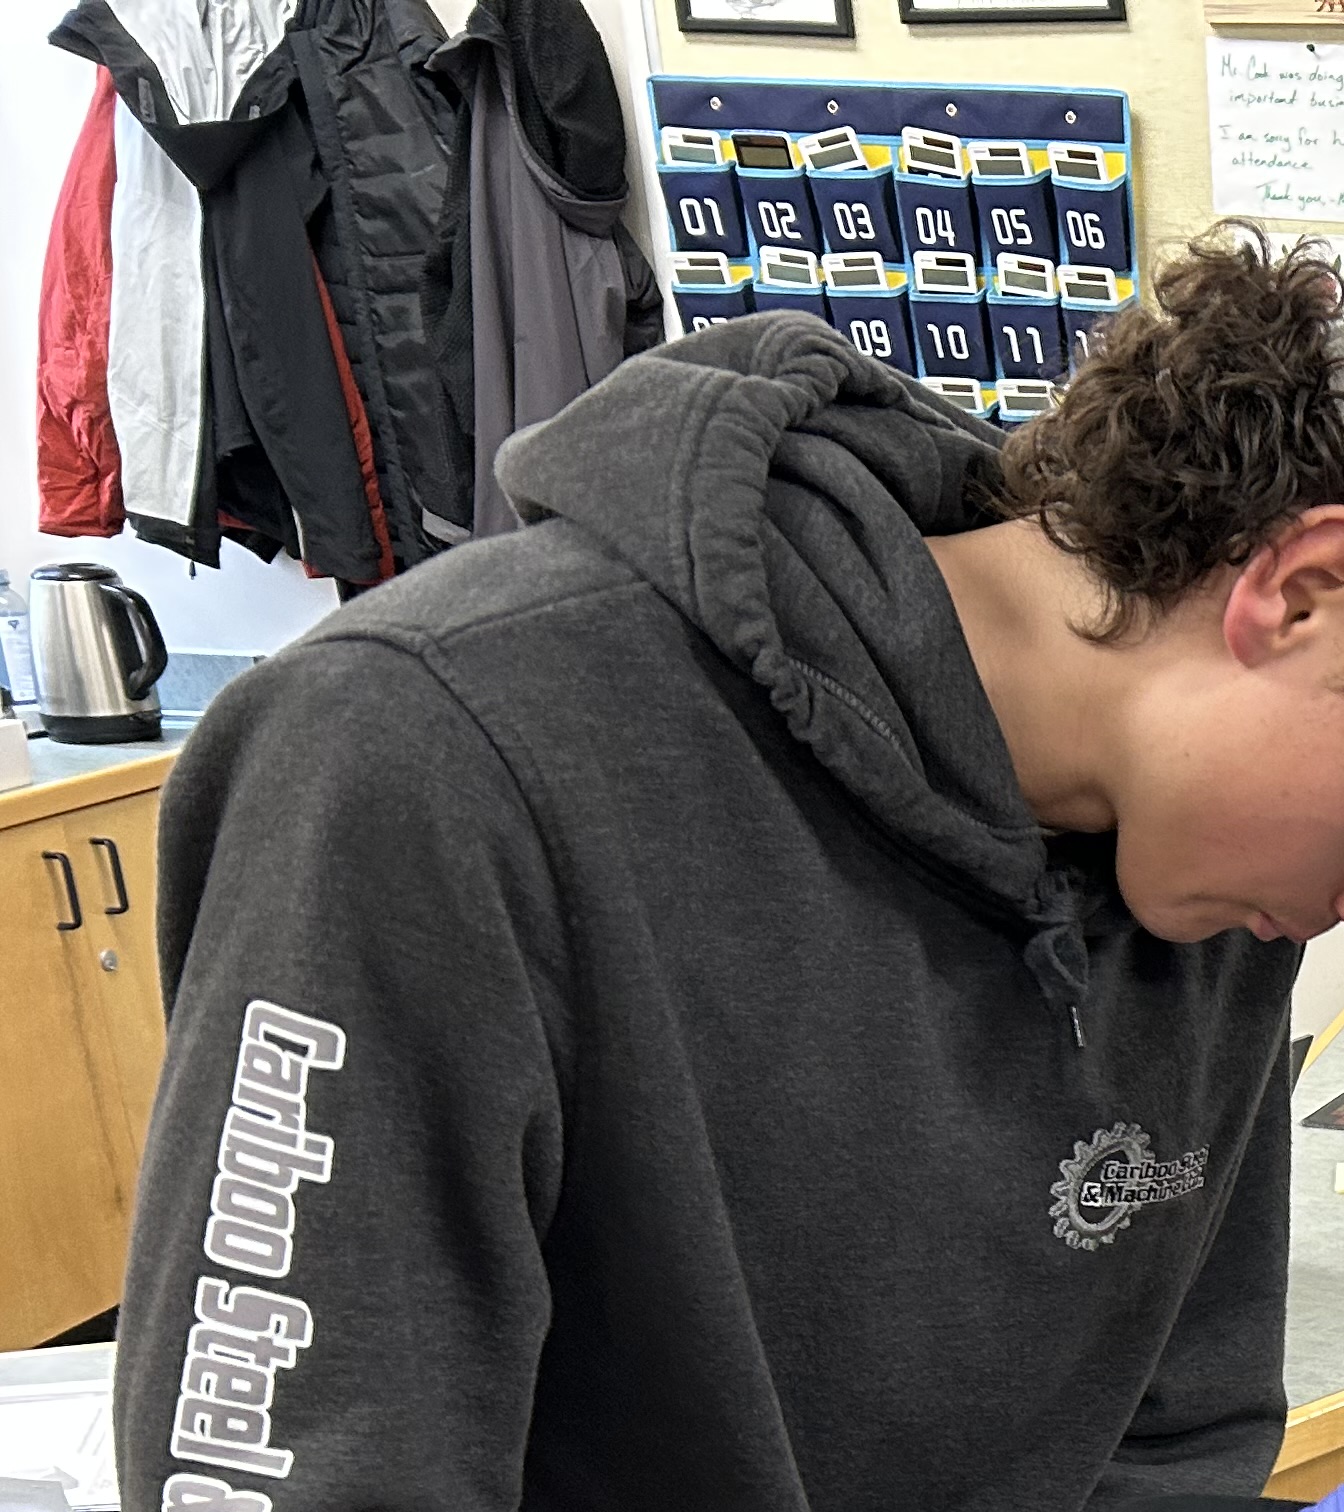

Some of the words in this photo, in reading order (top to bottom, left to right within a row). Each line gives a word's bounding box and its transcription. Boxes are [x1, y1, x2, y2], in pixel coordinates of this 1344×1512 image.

[1279, 71, 1302, 81] was
[1309, 65, 1344, 91] doing
[1229, 90, 1298, 108] important
[1219, 124, 1231, 139] I
[1264, 132, 1291, 152] sorry
[1298, 127, 1319, 147] for
[1232, 152, 1313, 169] attendance
[1256, 179, 1293, 203] Thank
[680, 198, 724, 237] 01
[759, 201, 801, 240] 02
[833, 202, 875, 241] 03
[916, 207, 955, 246] 04
[991, 207, 1032, 246] 05
[1066, 210, 1105, 249] 06
[850, 319, 892, 358] 09
[926, 322, 969, 360] 10
[1003, 326, 1044, 364] 11
[204, 1000, 346, 1278] Cariboo
[170, 1276, 314, 1479] Steel
